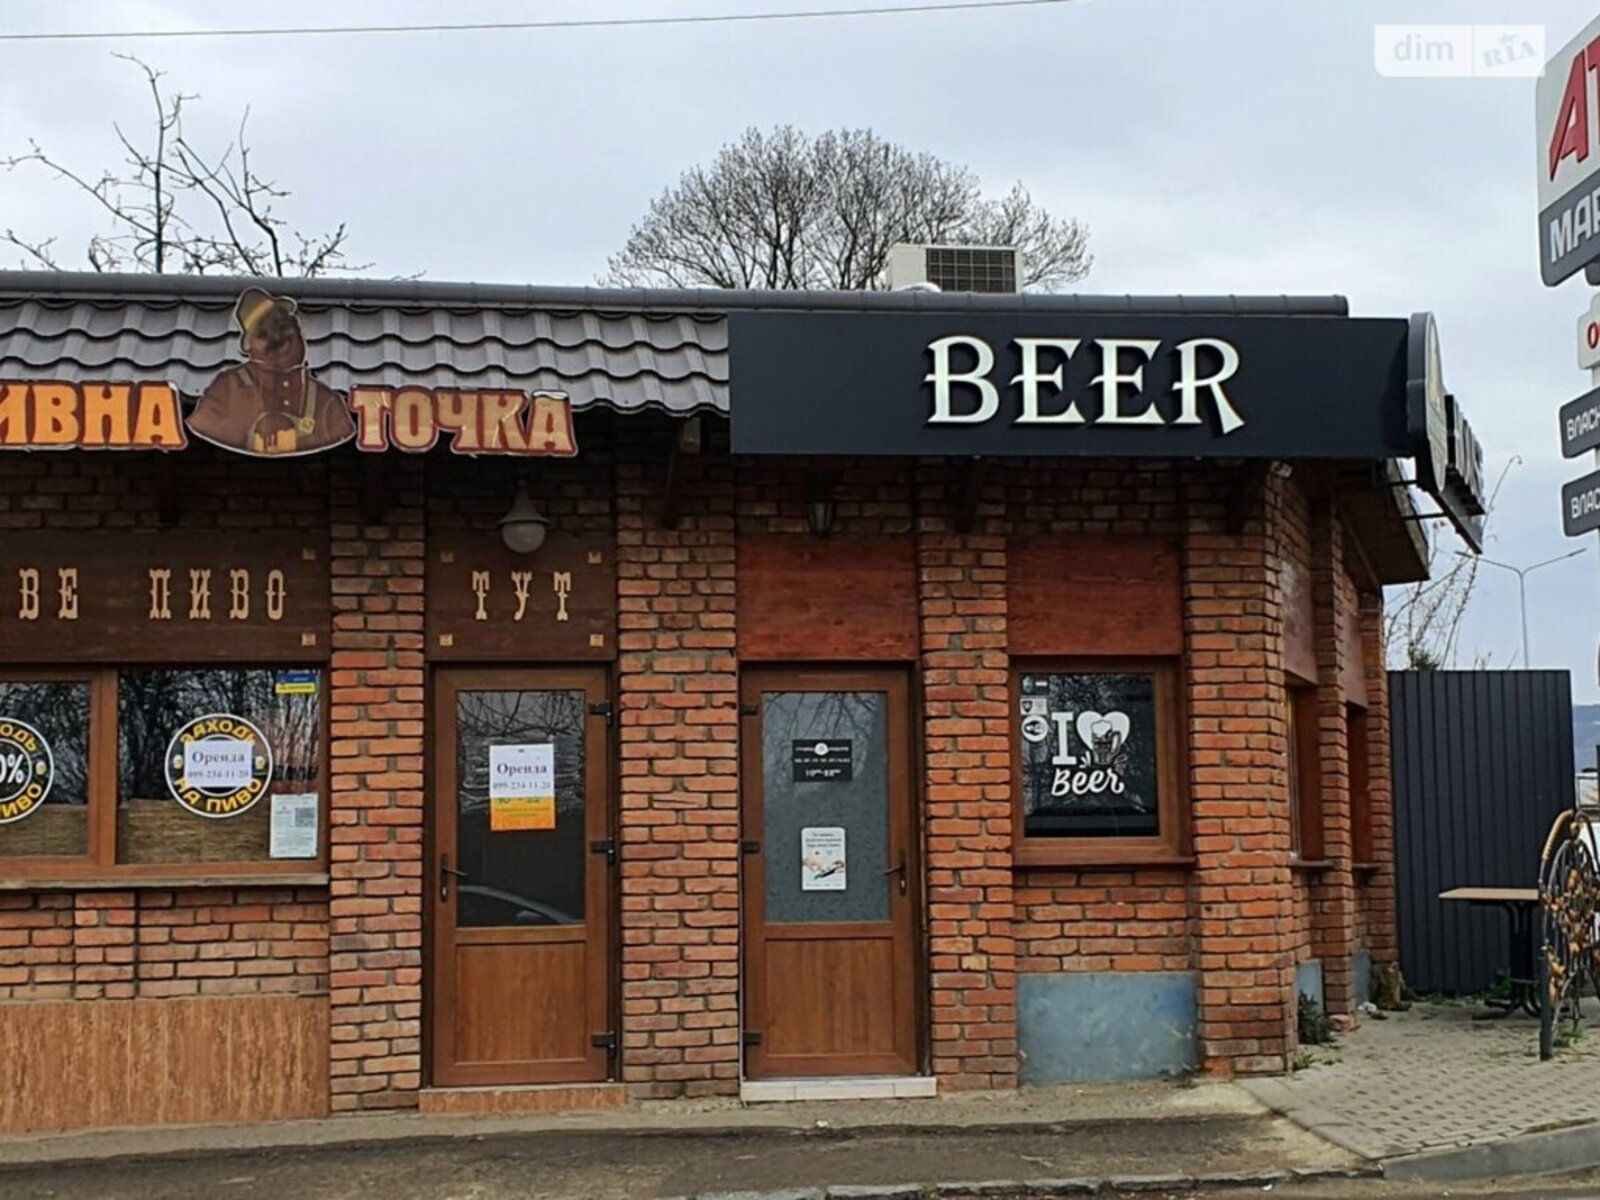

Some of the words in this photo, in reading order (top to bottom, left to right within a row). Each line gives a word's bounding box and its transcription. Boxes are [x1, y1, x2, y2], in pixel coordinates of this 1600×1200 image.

[922, 334, 1246, 435] BEER
[351, 386, 577, 455] ТОЧКА
[18, 567, 79, 621] ВЕ
[148, 567, 287, 621] ПИВО
[471, 570, 573, 622] ТУТ
[191, 751, 245, 766] Оренда
[1051, 711, 1077, 765] I
[496, 762, 548, 778] Оренда
[1051, 767, 1125, 797] Beer
[173, 777, 202, 806] НА
[205, 778, 263, 813] ПИВО
